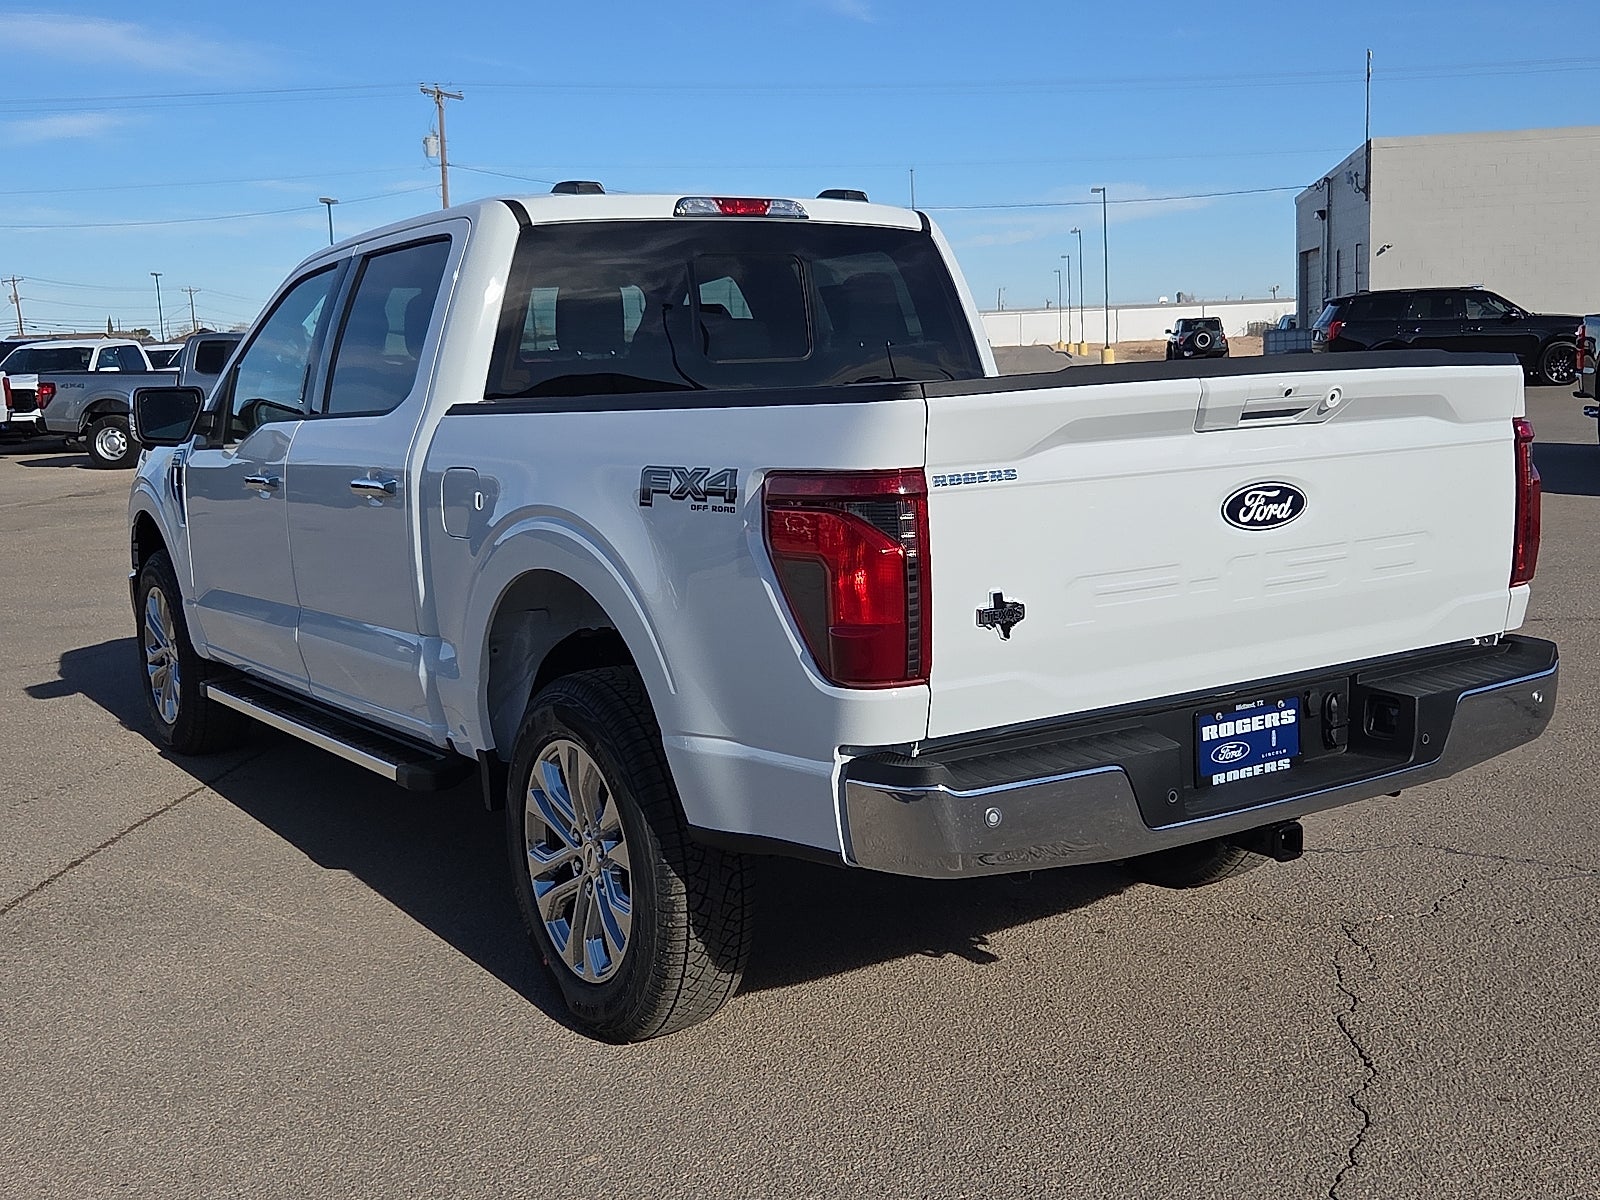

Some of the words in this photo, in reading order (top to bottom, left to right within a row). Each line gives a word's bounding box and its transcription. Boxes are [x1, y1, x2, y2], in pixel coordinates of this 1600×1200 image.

[639, 465, 738, 507] FX4
[932, 468, 1018, 487] ROGERS
[690, 504, 709, 512] OFF
[711, 505, 736, 514] ROAD
[1238, 489, 1294, 523] Ford
[983, 605, 1023, 624] TEXAS
[1201, 708, 1297, 742] ROGERS
[1217, 744, 1244, 761] Ford
[1261, 748, 1287, 759] LINCOLN
[1212, 758, 1291, 786] ROGERS
